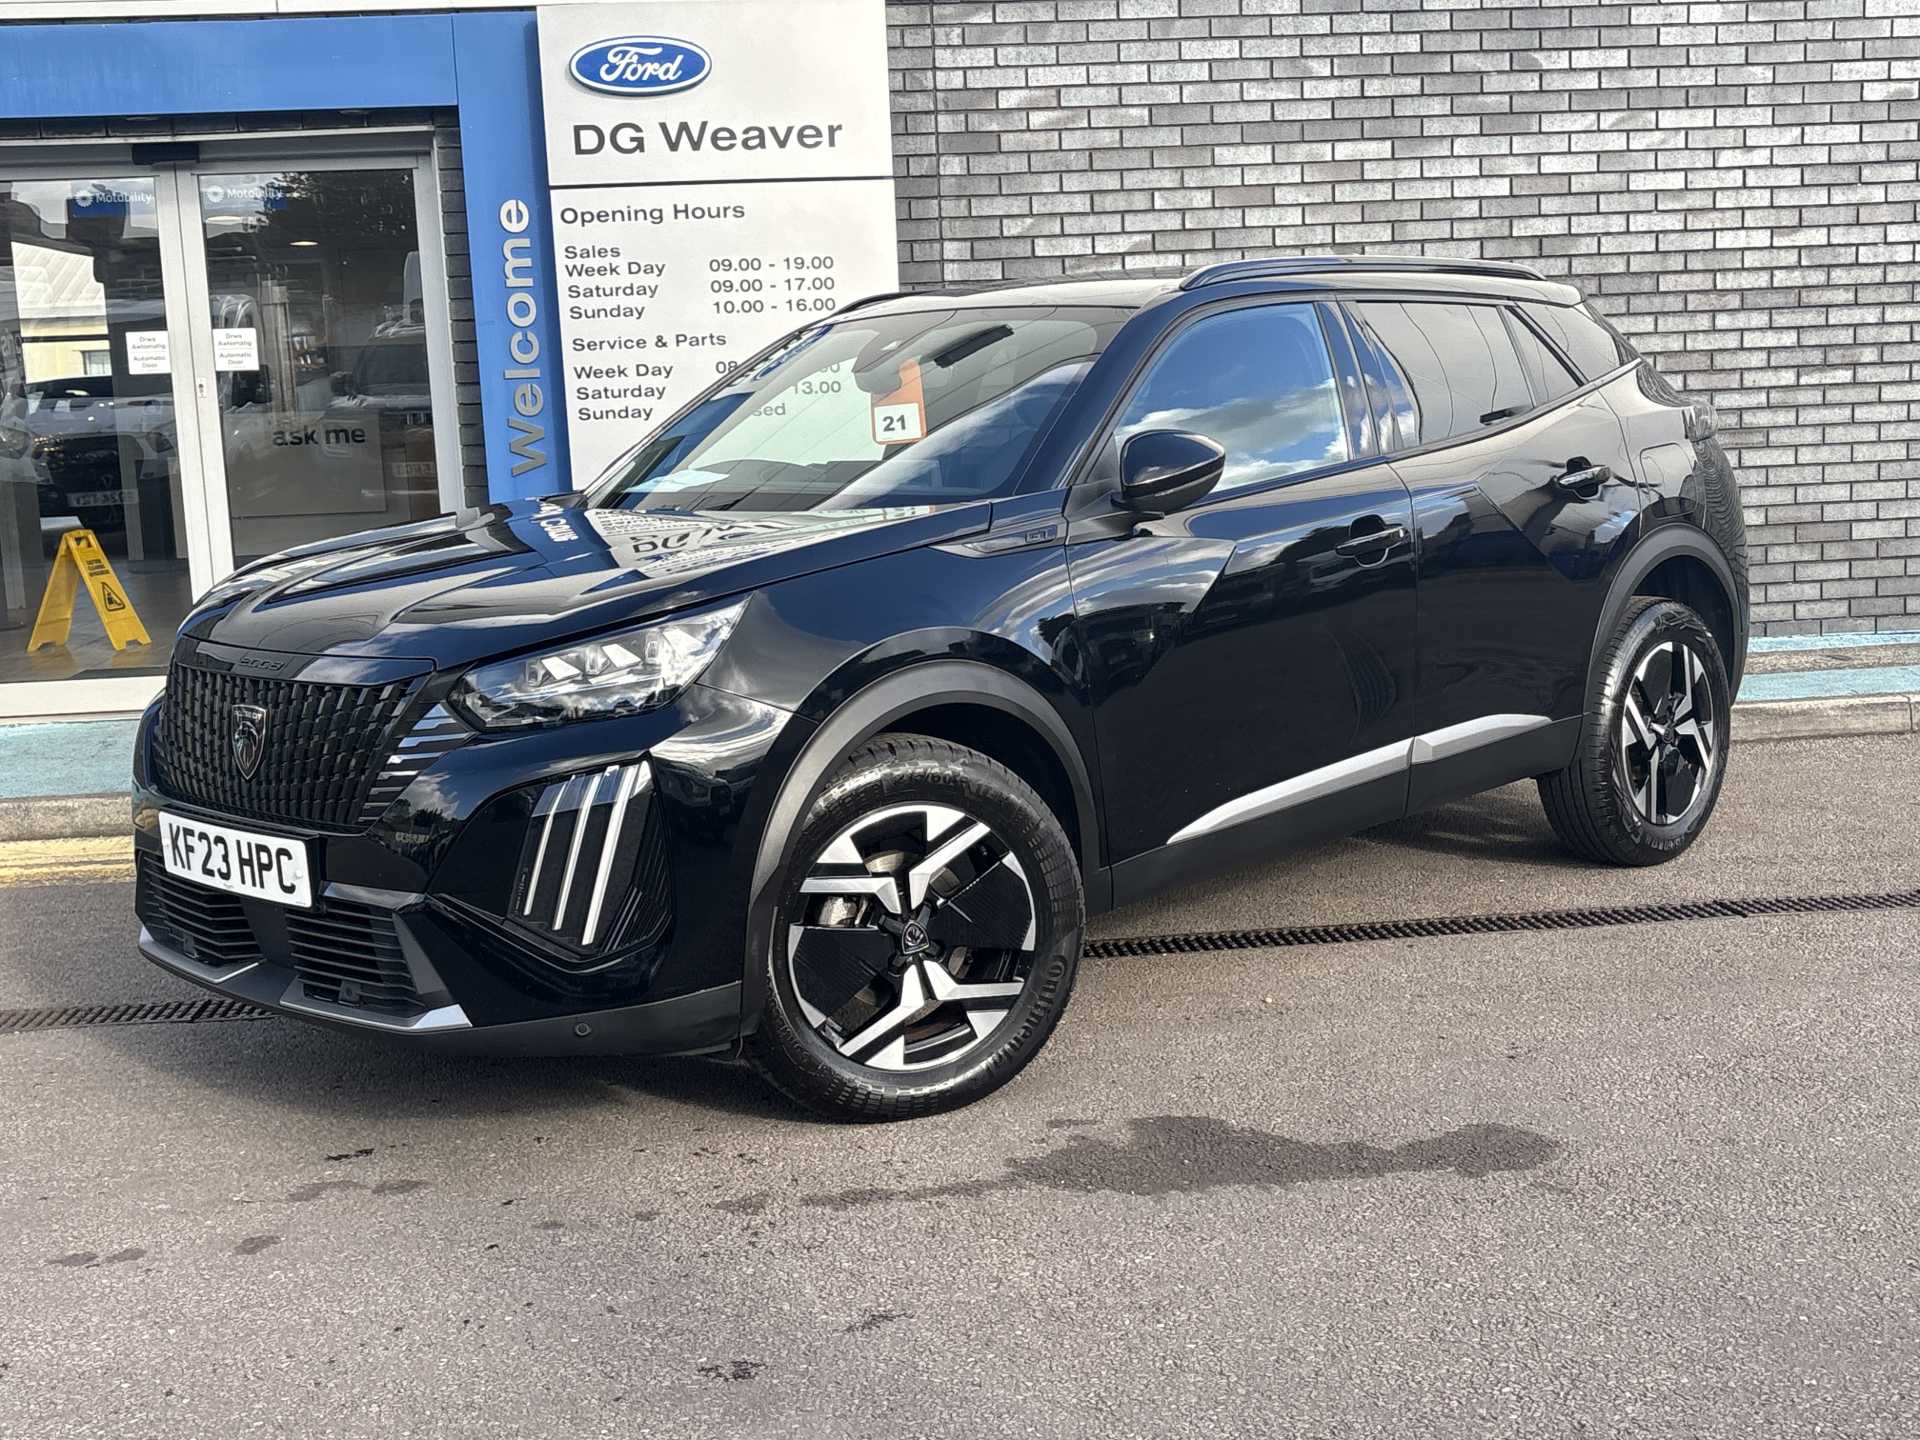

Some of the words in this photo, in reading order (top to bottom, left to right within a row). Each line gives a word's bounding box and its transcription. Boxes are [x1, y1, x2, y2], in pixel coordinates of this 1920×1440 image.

[599, 45, 685, 82] Ford
[572, 122, 646, 156] DG
[657, 120, 843, 153] Weaver
[559, 205, 664, 229] Opening
[672, 203, 746, 221] Hours
[564, 244, 621, 260] Sales
[564, 263, 621, 278] Week
[627, 261, 667, 278] Day
[709, 257, 762, 273] 09.00
[783, 255, 834, 271] 19.00
[567, 282, 659, 299] Saturday
[710, 279, 763, 294] 09.00
[784, 276, 835, 292] 17.00
[569, 304, 646, 321] Sunday
[712, 299, 765, 315] 10.00
[785, 297, 836, 314] 16.00
[499, 198, 548, 477] Welcome
[572, 335, 648, 352] Service
[654, 334, 669, 349] &
[675, 332, 727, 348] Parts
[572, 365, 629, 380] Week
[635, 363, 674, 380] Day
[576, 385, 667, 402] Saturday
[577, 406, 654, 422] Sunday
[882, 414, 906, 432] 21
[272, 425, 319, 446] ask
[325, 428, 366, 445] me
[168, 822, 232, 881] KF23
[235, 839, 297, 895] HPC
